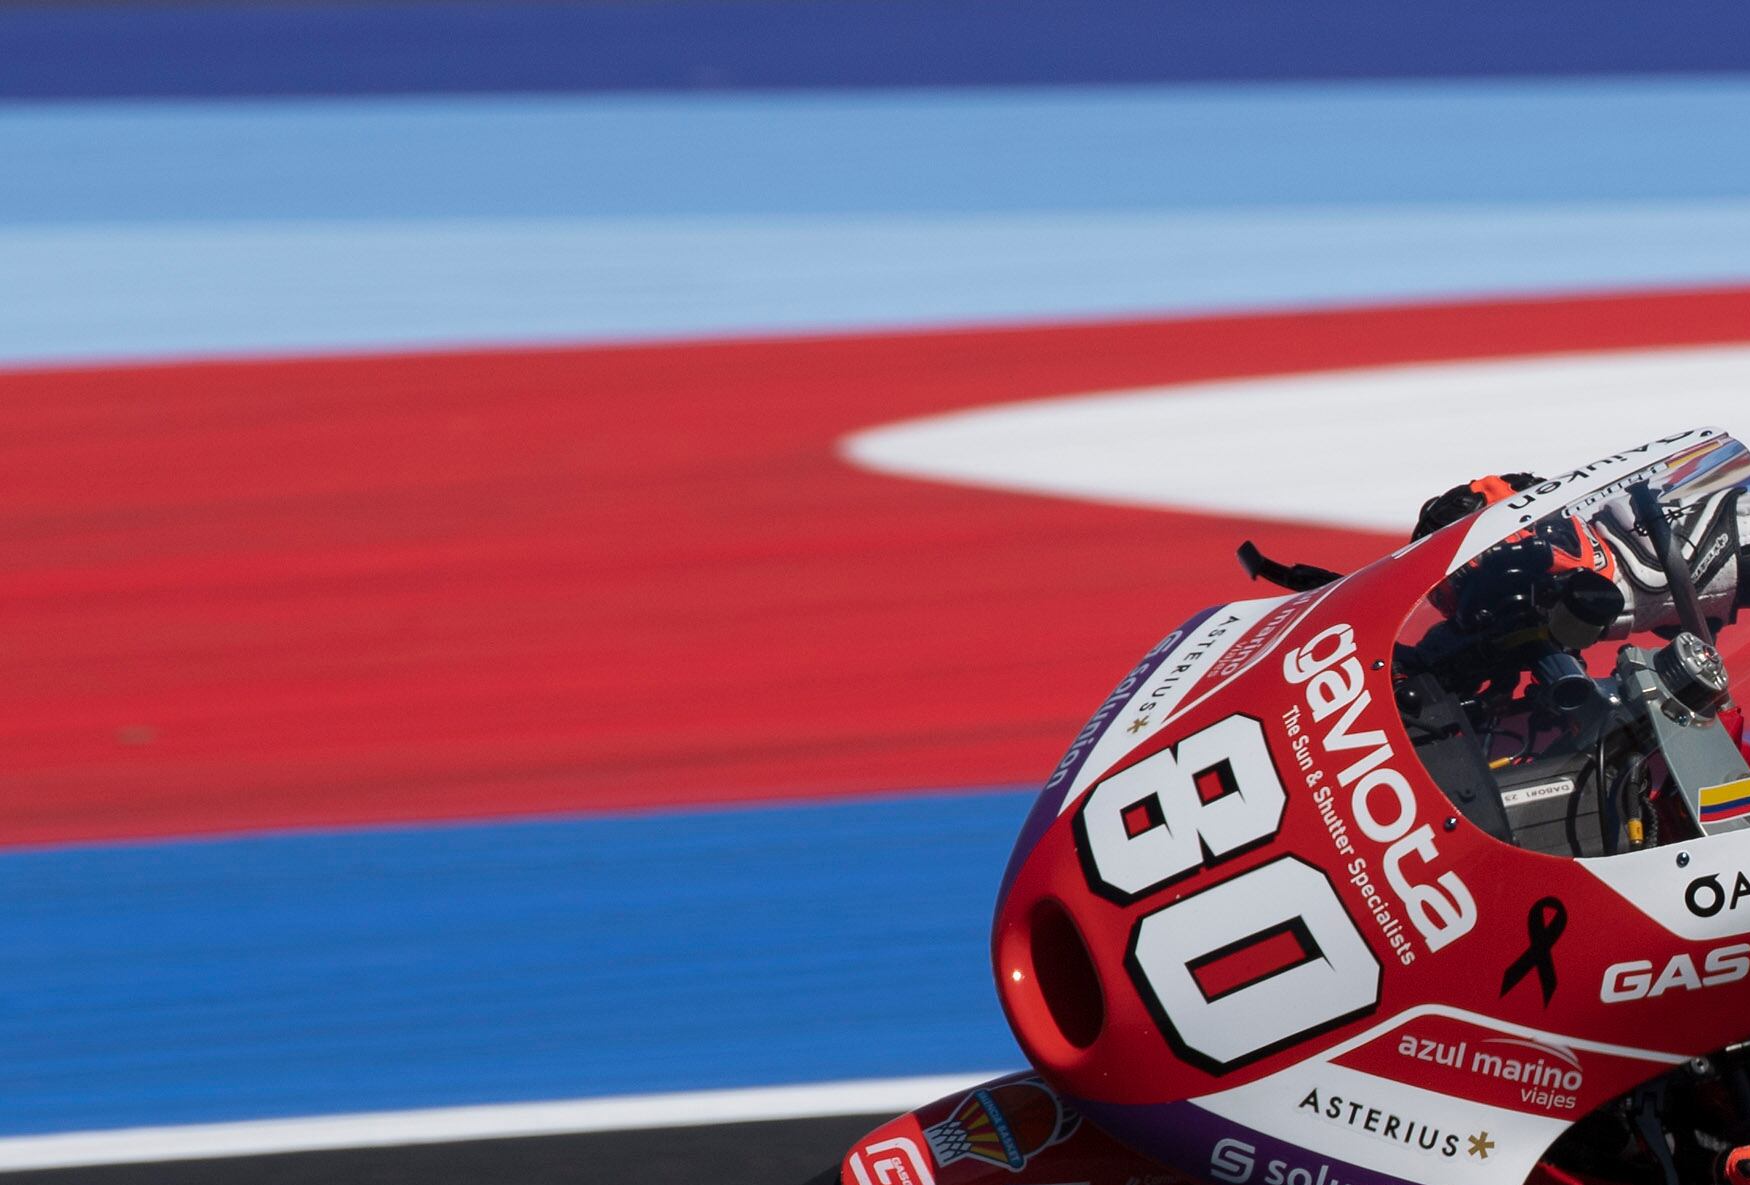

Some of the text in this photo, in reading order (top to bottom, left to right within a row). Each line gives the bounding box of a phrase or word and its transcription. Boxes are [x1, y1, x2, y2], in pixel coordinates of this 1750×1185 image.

[1139, 615, 1240, 713] ASTERIUS
[1281, 705, 1416, 966] The Sun & Shutter Specialists
[1283, 623, 1478, 953] gaviota
[1073, 712, 1384, 1075] 80
[1398, 1033, 1583, 1093] azul marino
[1520, 1087, 1577, 1111] viajes
[1299, 1087, 1461, 1158] ASTERIUS
